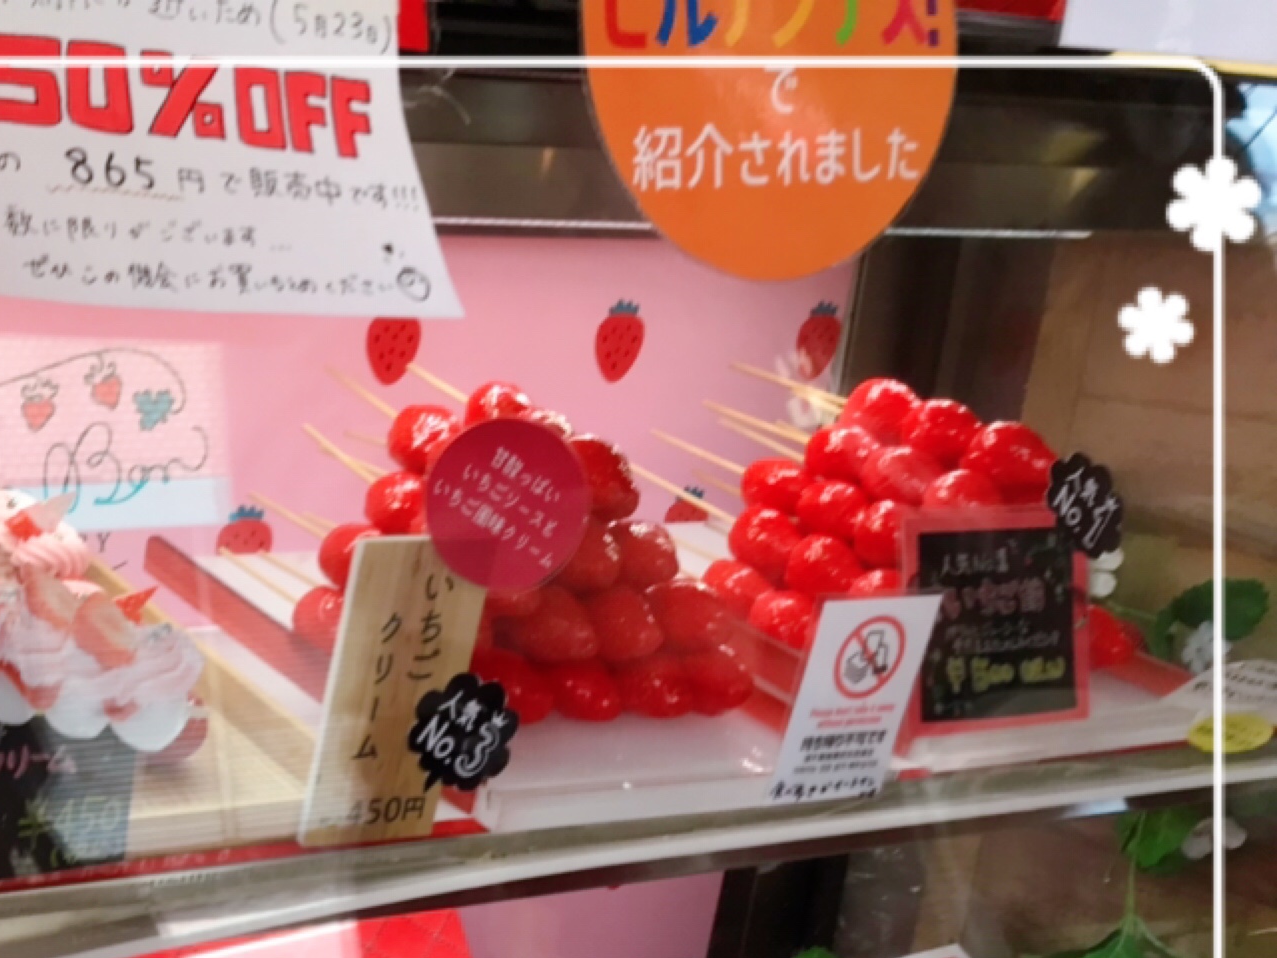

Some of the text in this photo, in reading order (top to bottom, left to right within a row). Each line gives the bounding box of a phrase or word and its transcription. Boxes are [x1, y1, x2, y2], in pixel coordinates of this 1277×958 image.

[632, 122, 921, 192] 紹介されました
[408, 573, 453, 681] いちご
[352, 612, 402, 762] クリーム
